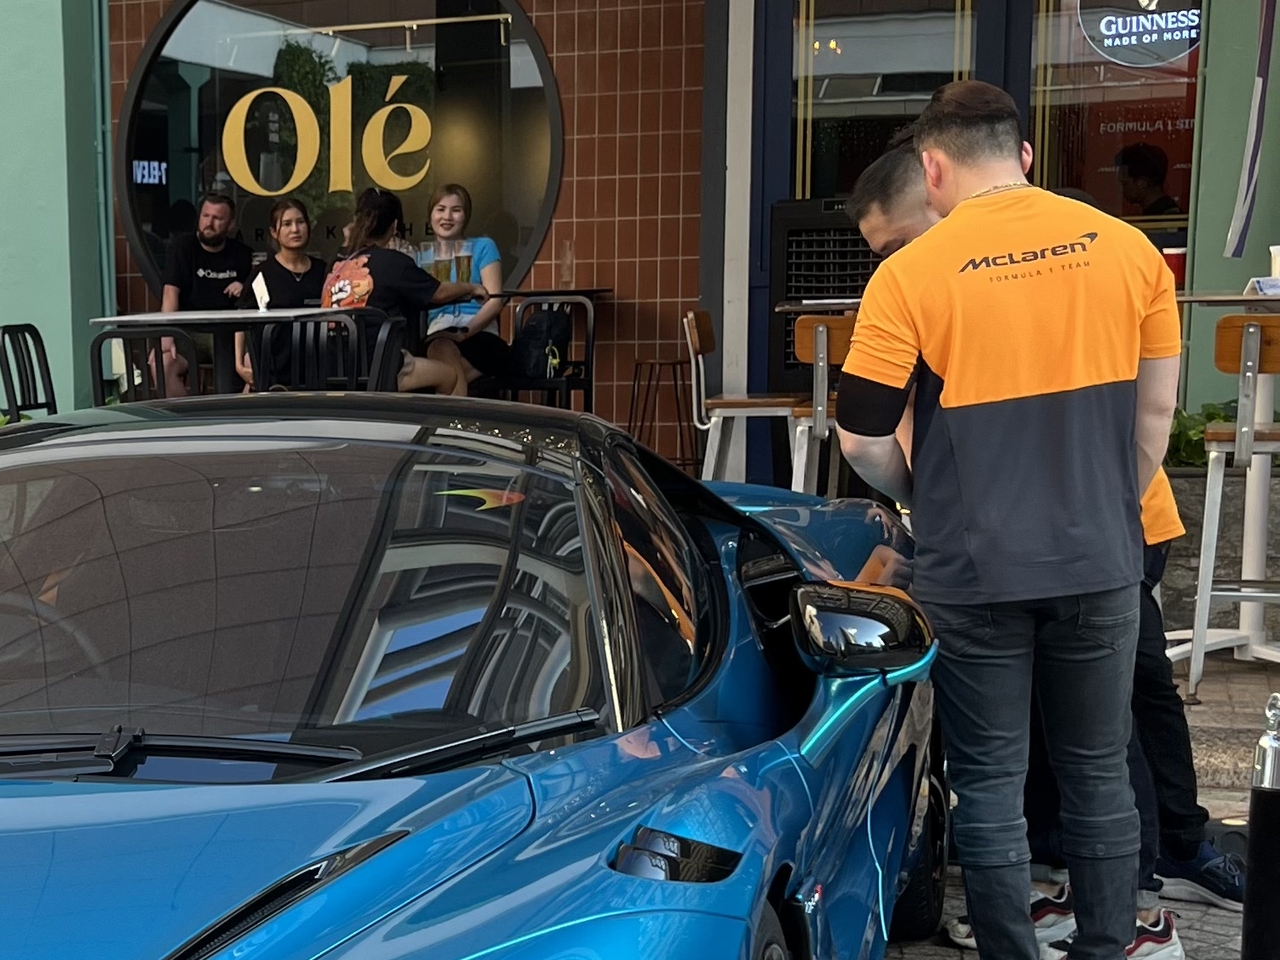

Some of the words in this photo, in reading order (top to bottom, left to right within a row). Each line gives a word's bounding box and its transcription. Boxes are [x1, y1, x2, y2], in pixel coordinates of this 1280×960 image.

[1100, 9, 1200, 35] GUINNESS
[1104, 36, 1137, 47] MADE
[1142, 34, 1158, 43] OF
[1163, 30, 1197, 41] MORE
[222, 75, 432, 196] Olé
[1100, 120, 1163, 134] FORMULA
[958, 241, 1088, 274] McLaren
[989, 269, 1042, 283] FORMULA
[1061, 261, 1091, 271] TEAM
